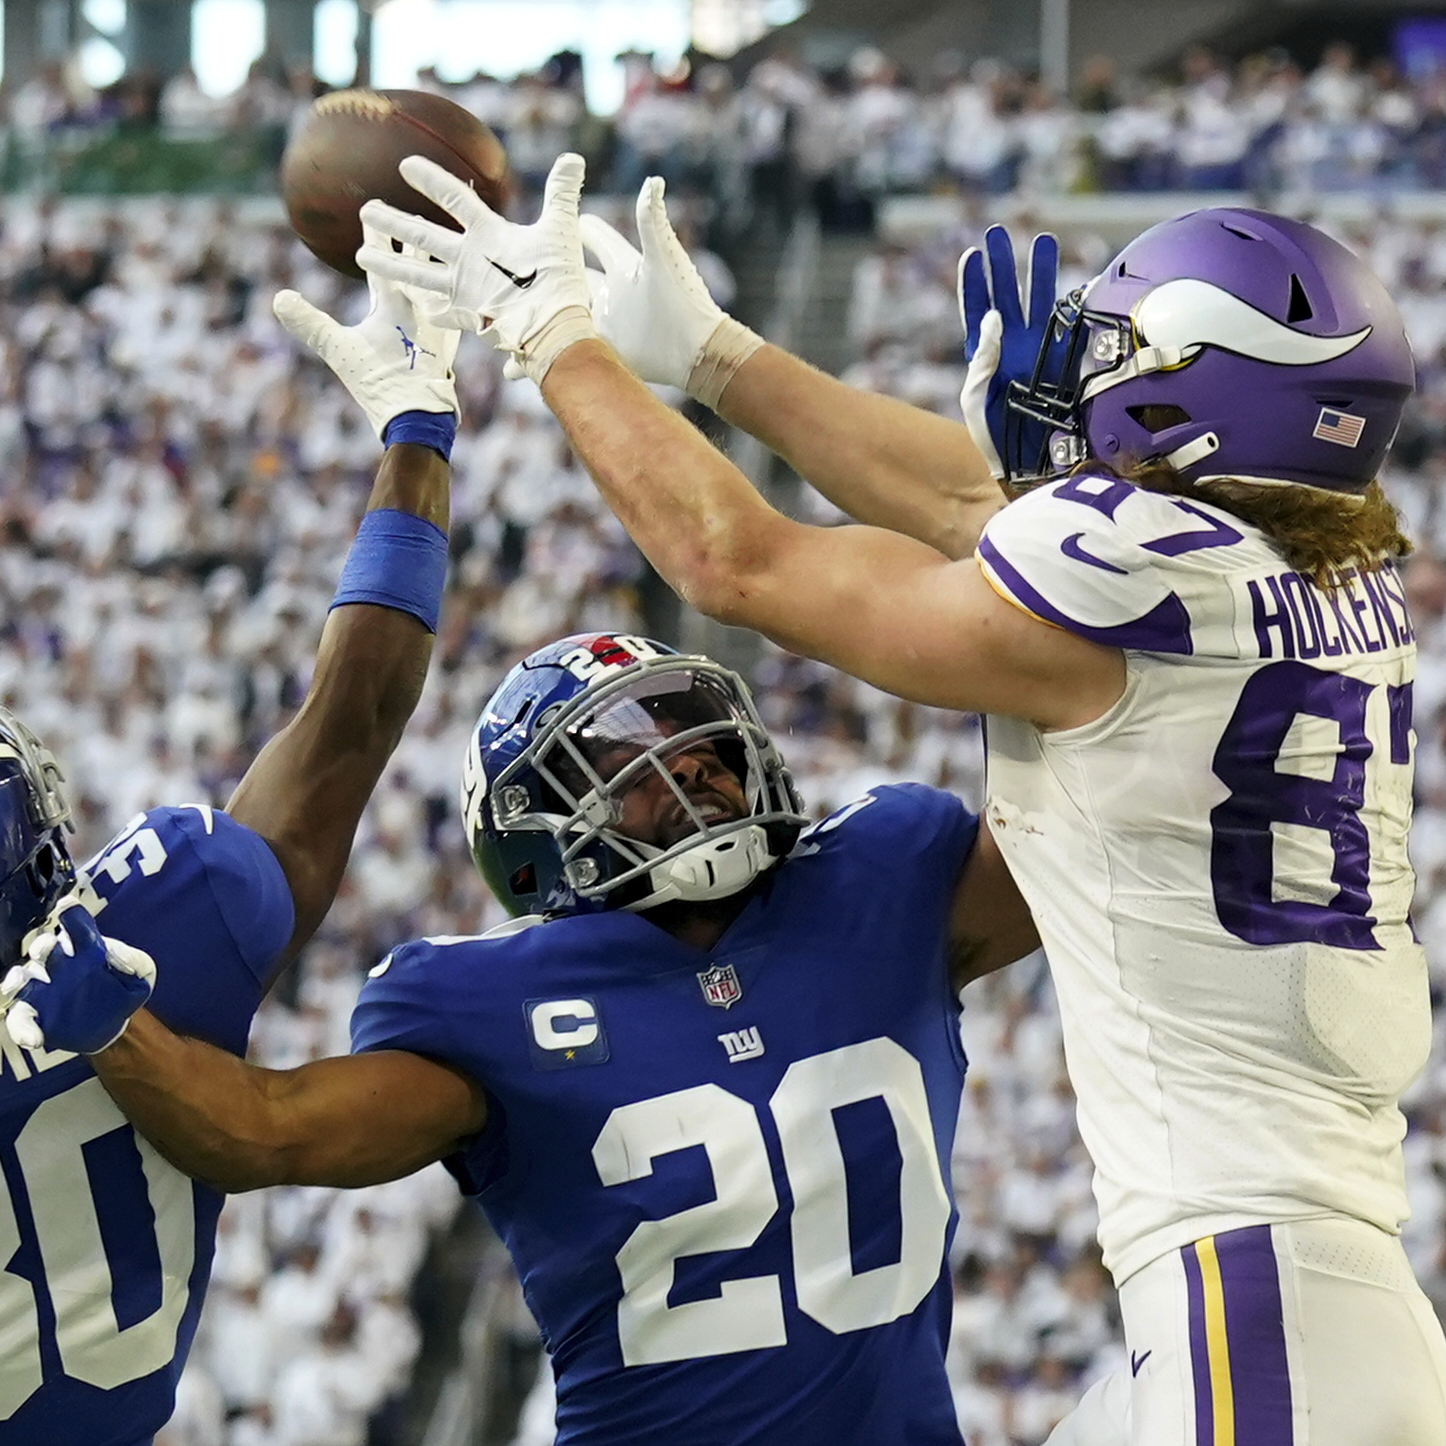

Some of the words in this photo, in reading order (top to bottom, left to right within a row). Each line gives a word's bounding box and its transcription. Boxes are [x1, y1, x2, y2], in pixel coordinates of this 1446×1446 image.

[1246, 558, 1416, 660] HOCKENS
[531, 999, 598, 1051] C
[707, 981, 737, 1001] NFL
[592, 1035, 952, 1367] 20
